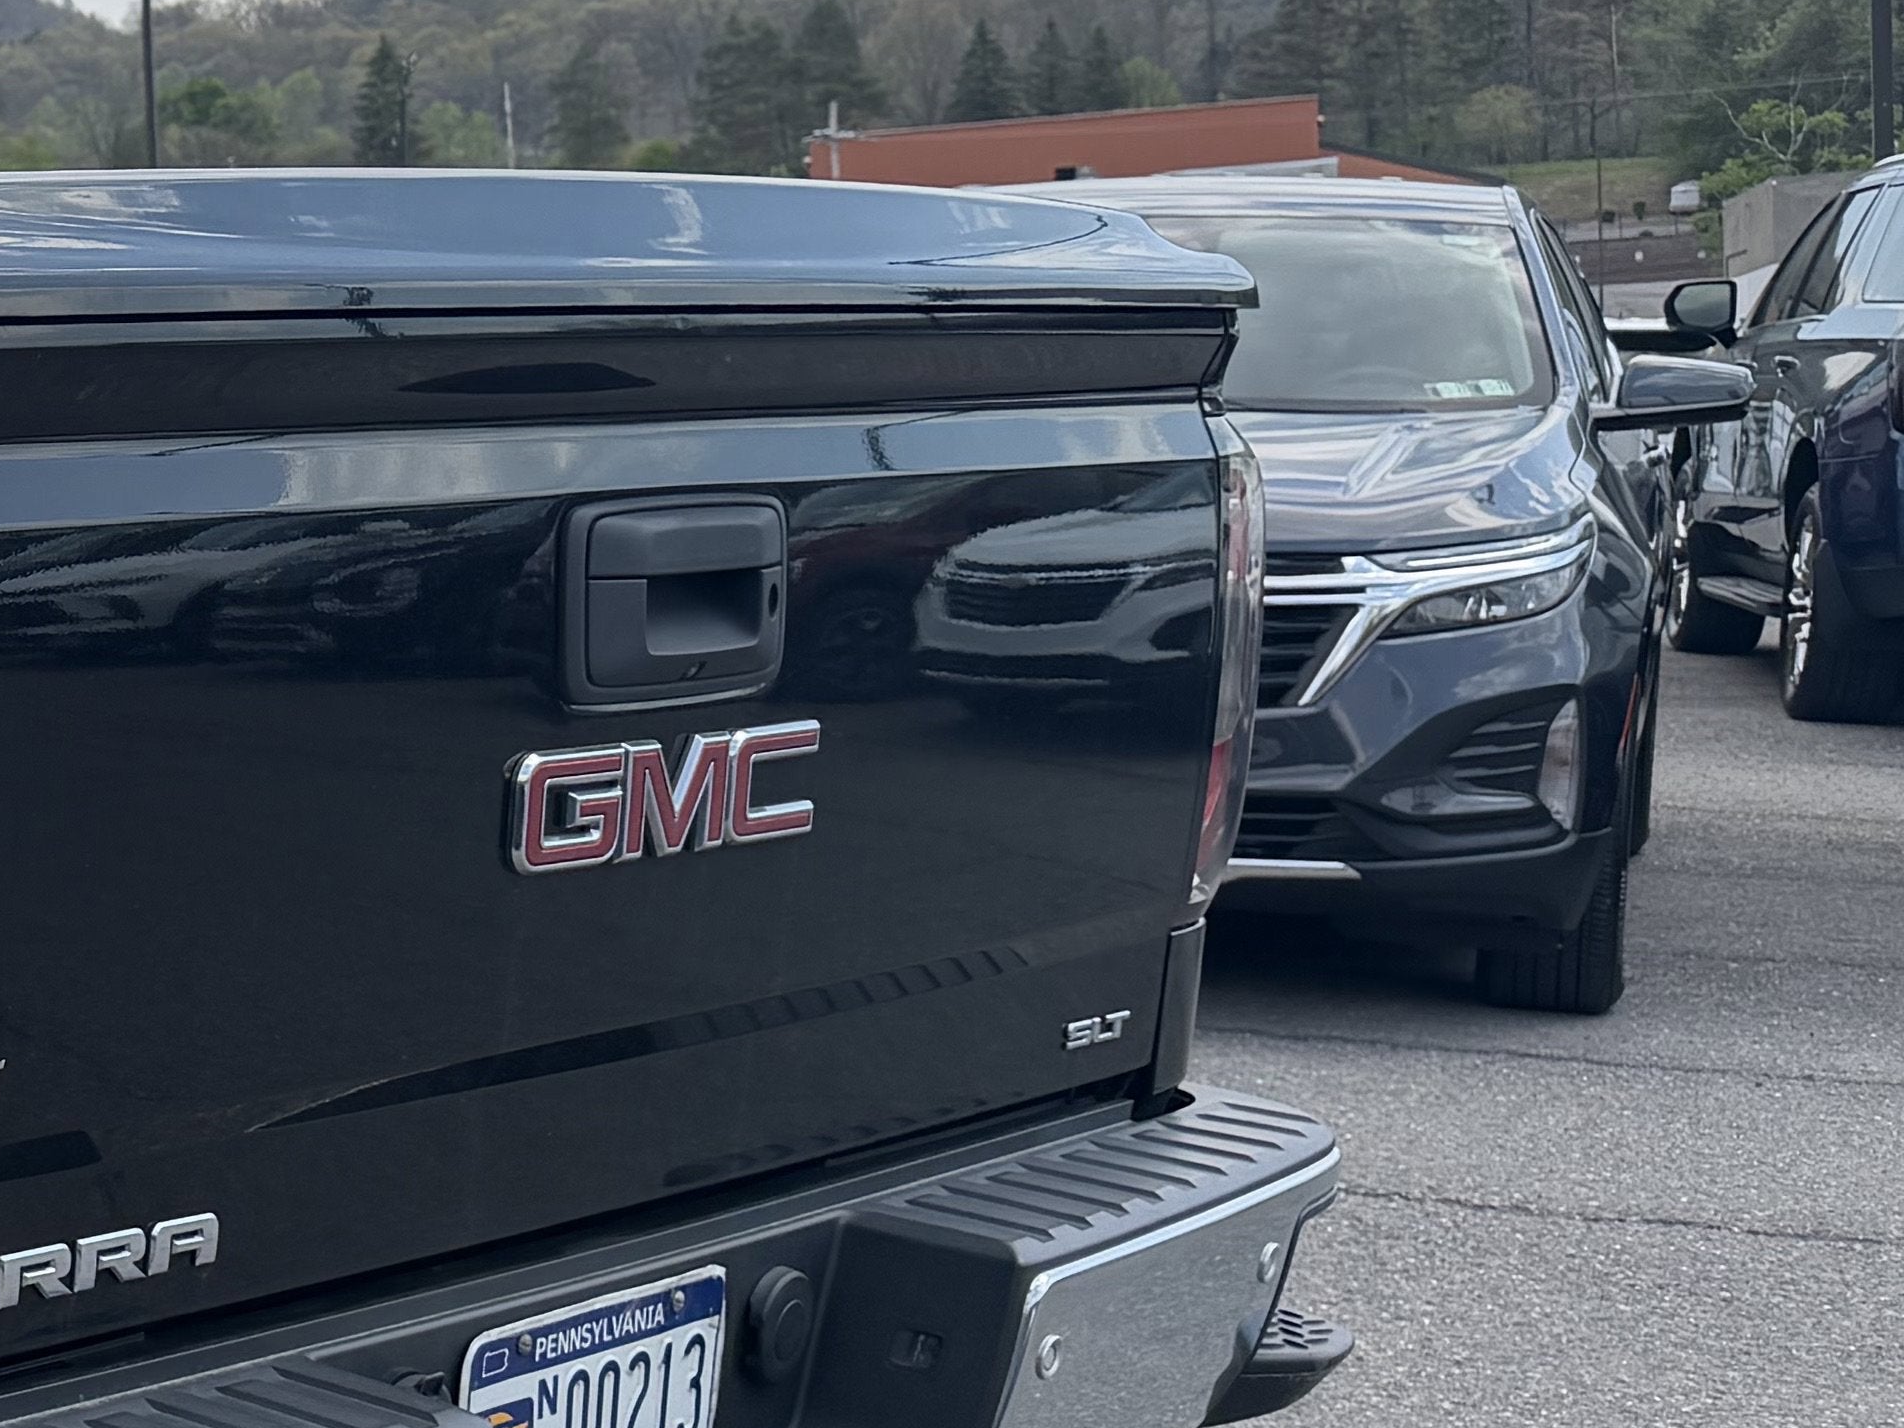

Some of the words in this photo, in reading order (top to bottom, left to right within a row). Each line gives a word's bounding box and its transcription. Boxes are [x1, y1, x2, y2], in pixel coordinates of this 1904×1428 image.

[505, 719, 822, 877] GMC
[1063, 1009, 1131, 1051] SLT
[534, 1303, 665, 1363] PENNSYLVANIA
